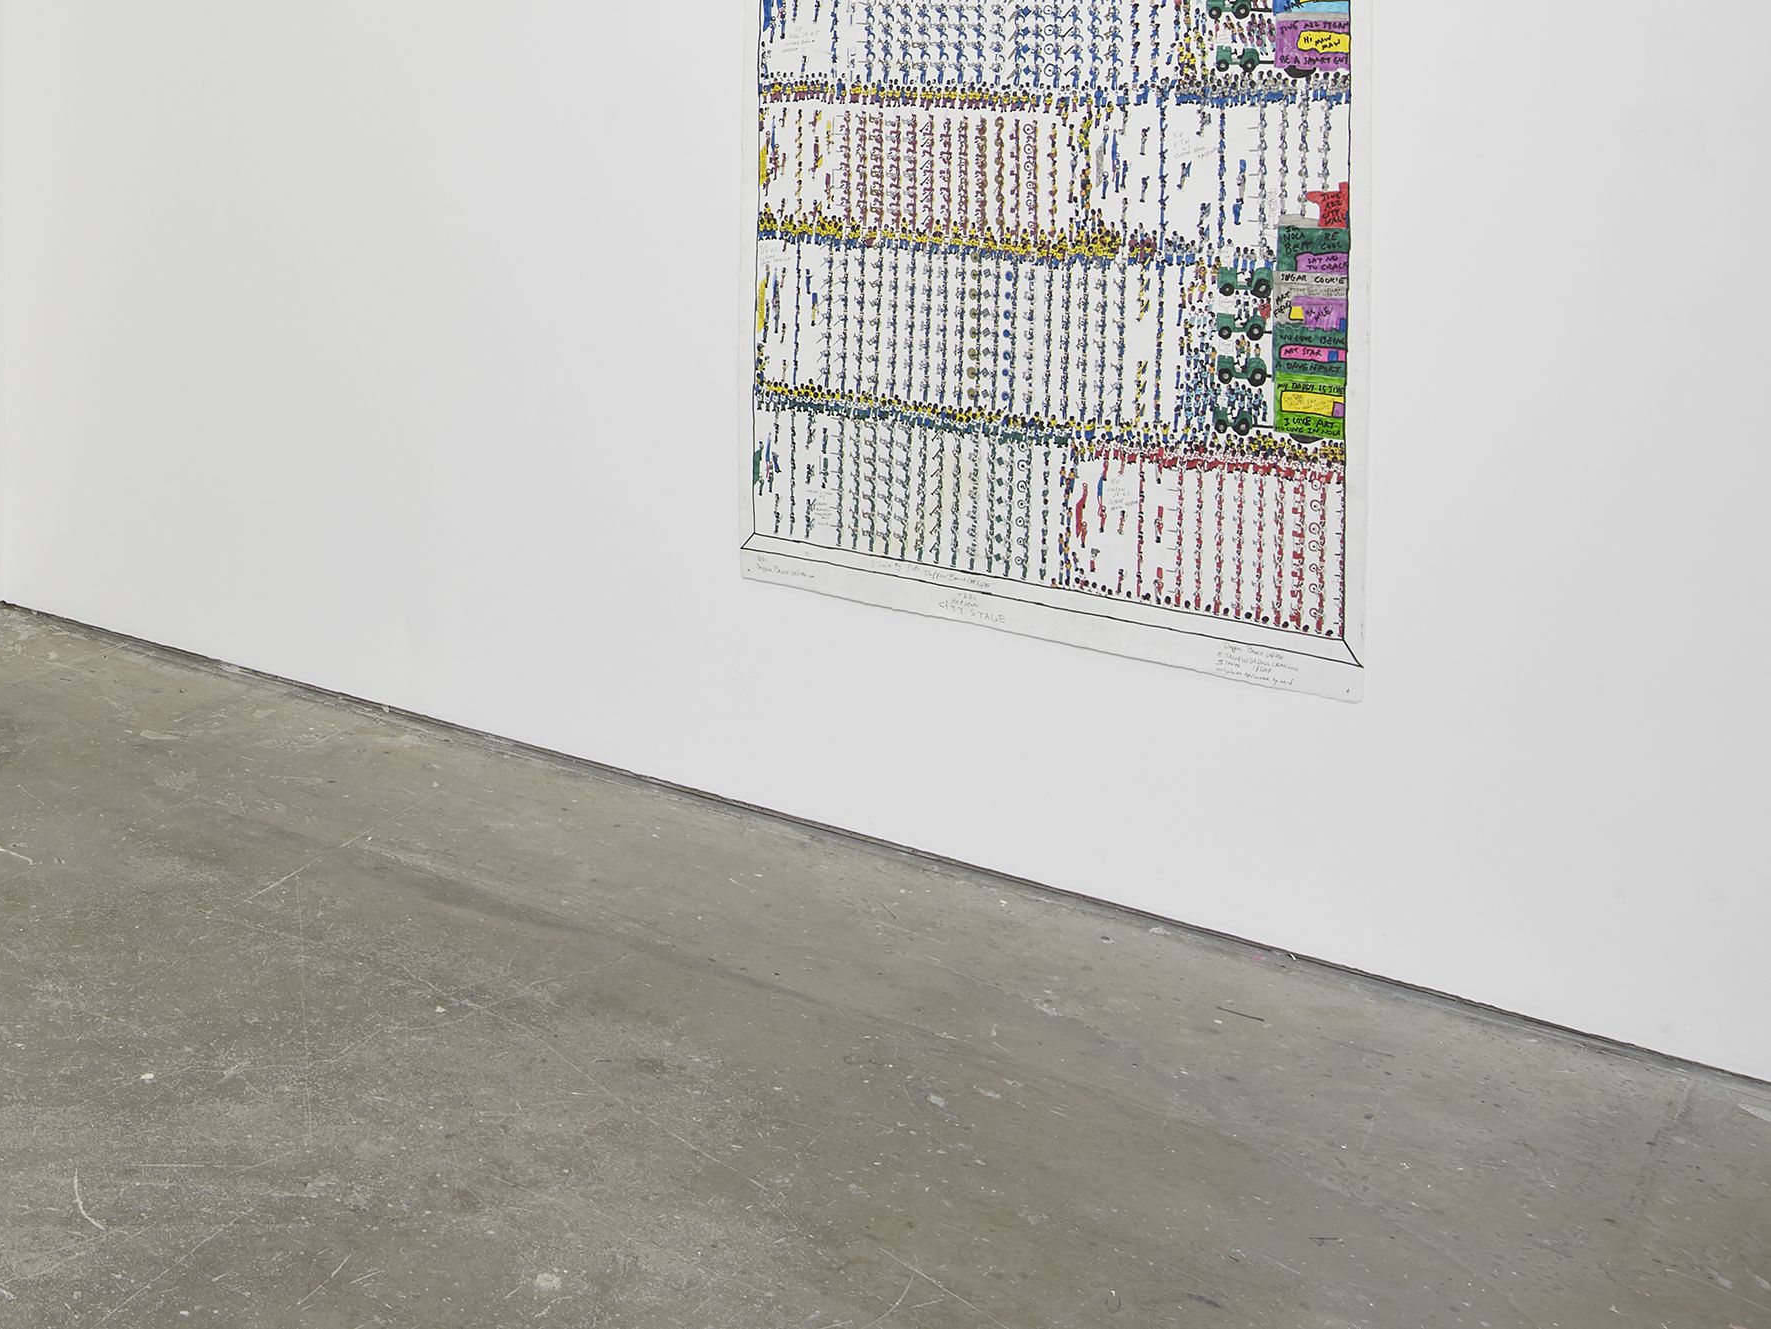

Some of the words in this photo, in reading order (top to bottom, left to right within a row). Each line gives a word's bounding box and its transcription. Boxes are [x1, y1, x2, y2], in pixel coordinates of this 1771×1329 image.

[1279, 55, 1291, 64] BE
[1294, 56, 1300, 64] A
[1304, 55, 1331, 65] SMART
[1283, 232, 1306, 241] NOLA
[1284, 240, 1314, 254] BEST
[1320, 241, 1343, 250] COOL
[1308, 257, 1323, 265] SAY
[1321, 262, 1348, 271] CRACK
[1280, 273, 1308, 282] SUGAR
[1314, 276, 1348, 285] COOKIE
[1302, 347, 1323, 357] STAR
[1292, 382, 1315, 391] DADDY
[1284, 417, 1291, 427] I
[1292, 416, 1312, 426] LOVE
[1315, 418, 1335, 428] ART
[970, 608, 1007, 624] STAGE
